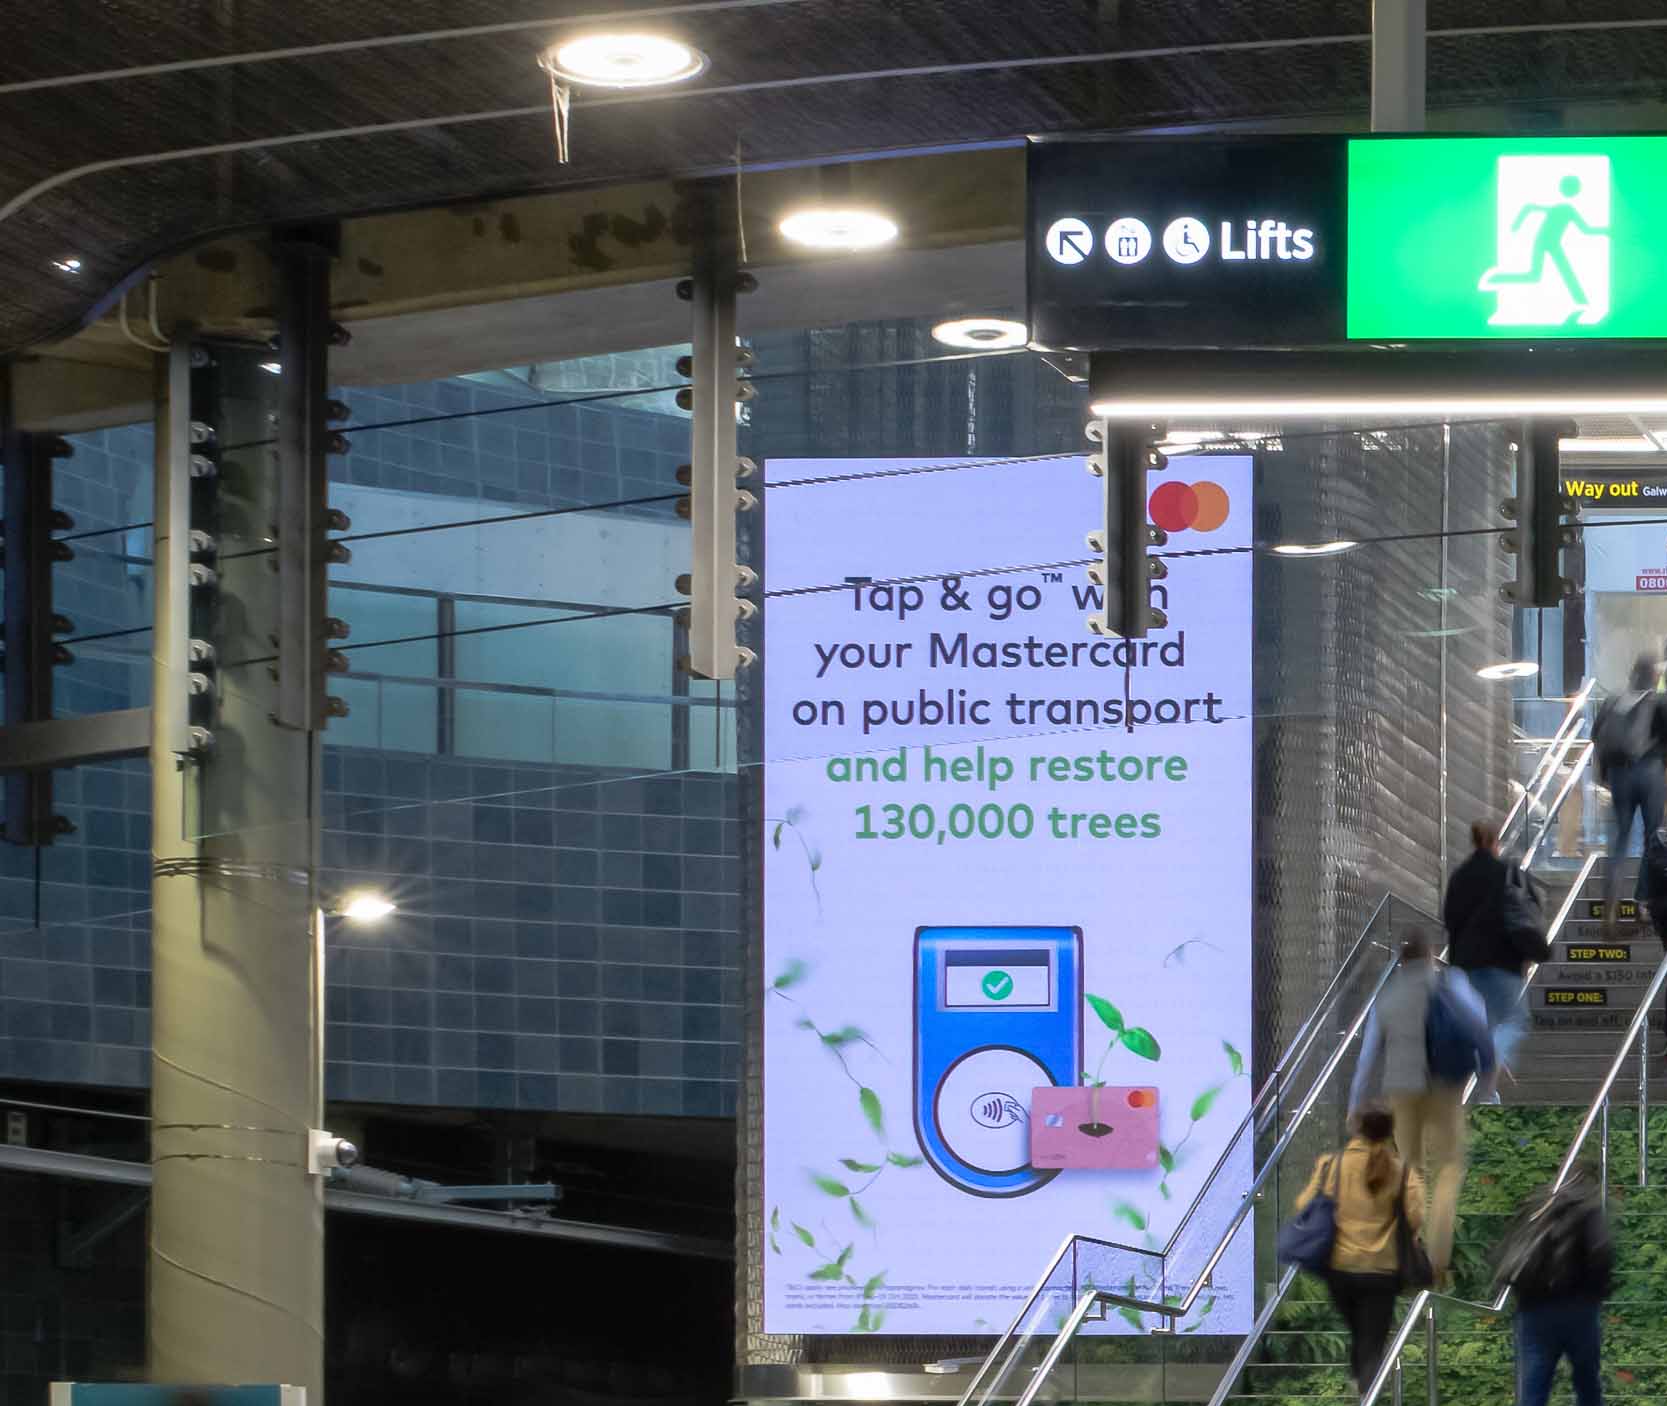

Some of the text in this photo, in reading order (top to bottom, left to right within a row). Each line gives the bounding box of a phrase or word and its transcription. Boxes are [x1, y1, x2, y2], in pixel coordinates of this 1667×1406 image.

[1221, 219, 1315, 262] Lifts
[1565, 481, 1606, 500] Way
[1609, 481, 1638, 497] out
[845, 577, 924, 619] Tap
[941, 577, 972, 611] &
[814, 632, 1185, 679] your Mastercard
[792, 689, 1224, 734] on public transport
[826, 746, 1188, 791] and help restore
[854, 803, 1162, 845] 130,000 trees
[1569, 949, 1628, 960] STEP TWO:
[1547, 992, 1604, 1003] STEP ONE:
